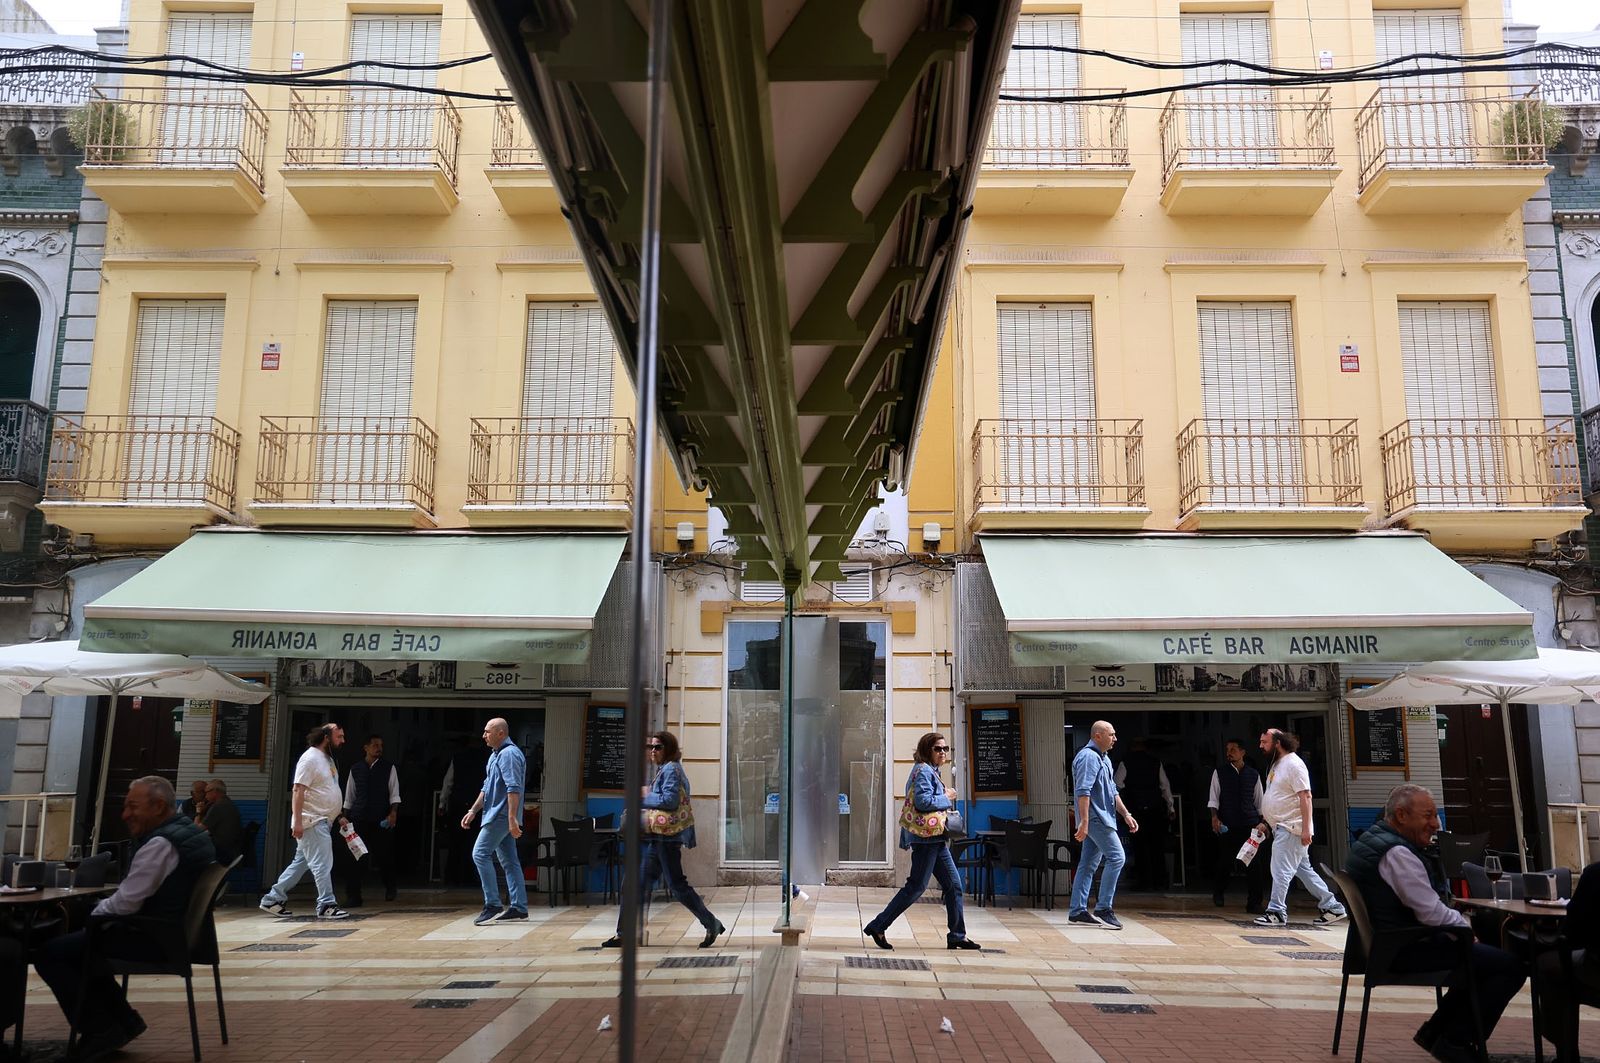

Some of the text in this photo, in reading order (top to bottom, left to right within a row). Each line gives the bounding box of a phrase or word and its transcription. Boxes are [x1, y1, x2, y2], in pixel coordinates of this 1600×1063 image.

[1014, 641, 1078, 653] Centro Suizo
[1163, 632, 1379, 655] CAFÉ BAR AGMANIR
[1465, 636, 1530, 648] Centro Suizo
[1090, 675, 1126, 688] 1963
